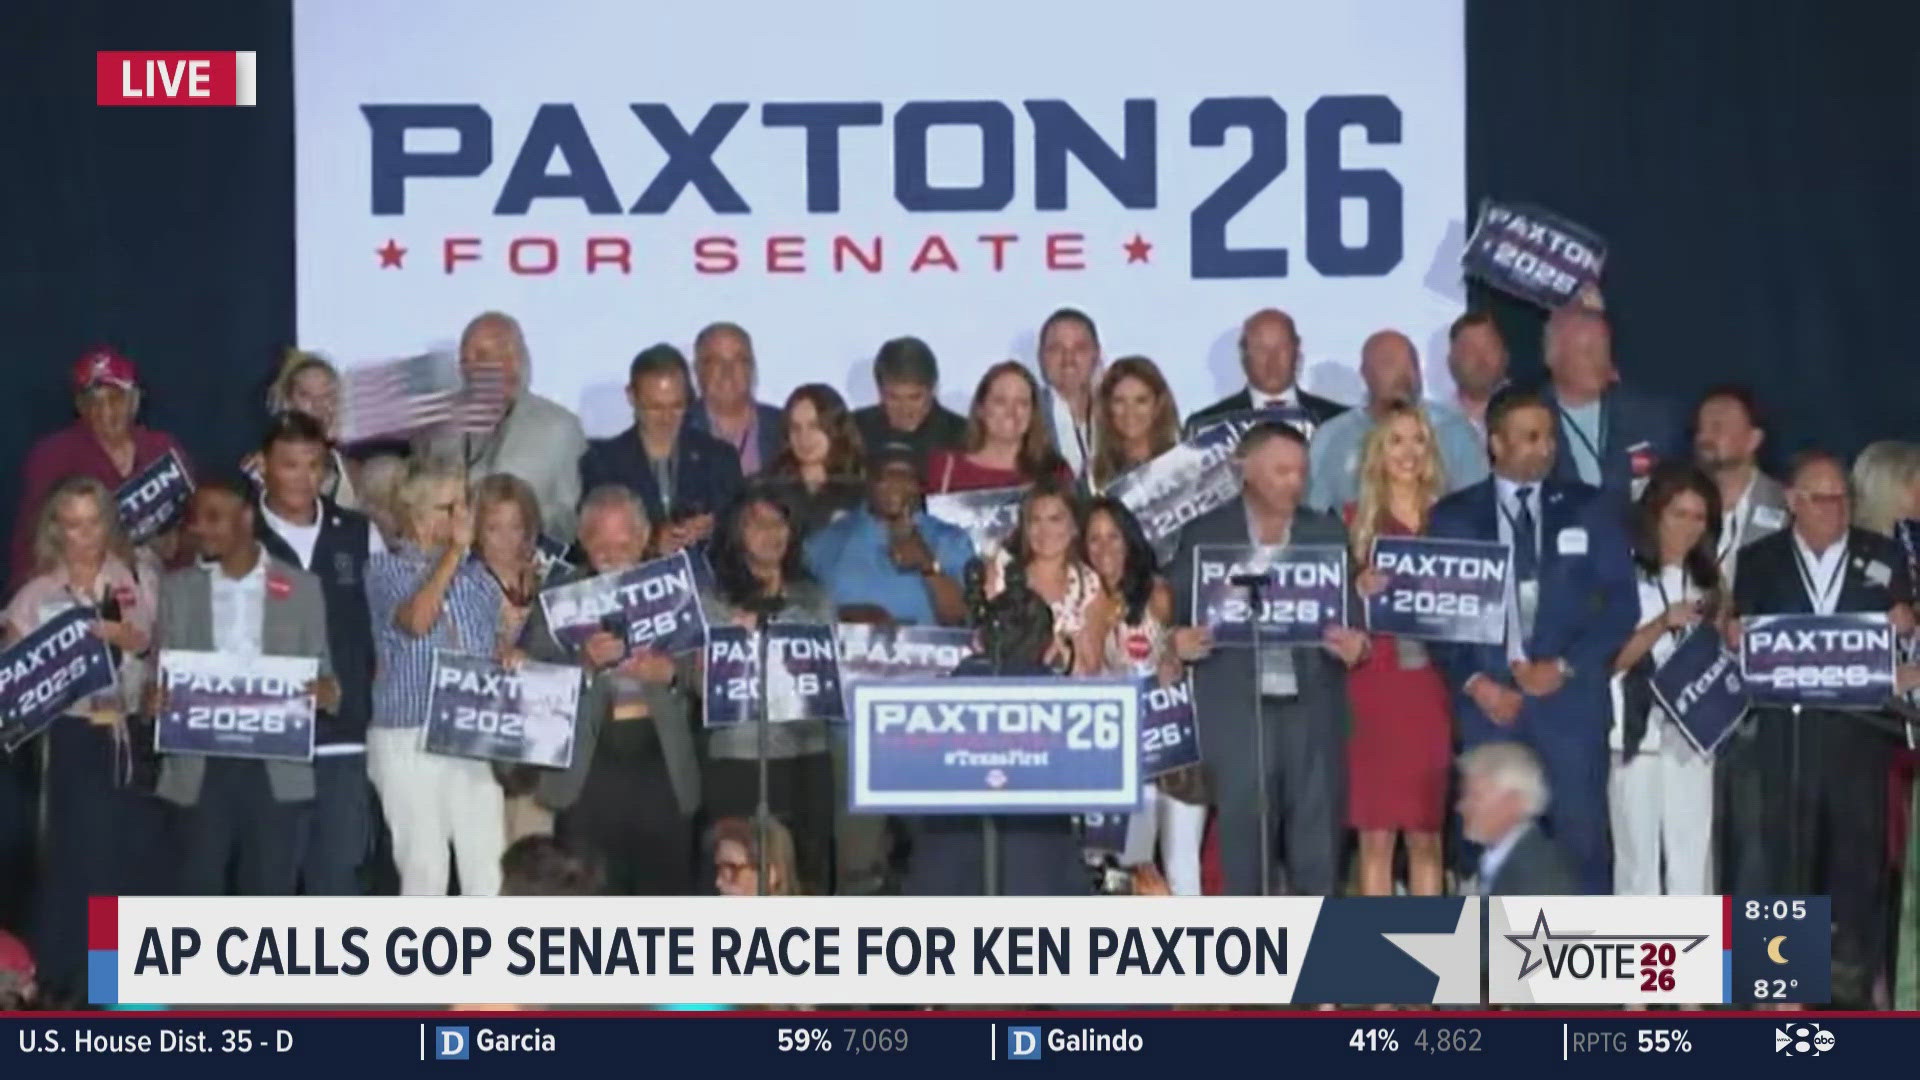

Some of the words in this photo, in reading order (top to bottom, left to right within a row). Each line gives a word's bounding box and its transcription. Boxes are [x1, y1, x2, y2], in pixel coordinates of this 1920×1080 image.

[359, 98, 1157, 215] PAXTON
[1190, 95, 1403, 279] 26
[444, 236, 632, 275] FOR
[694, 233, 1085, 273] SENATE
[1376, 552, 1505, 581] PAXTON
[1393, 589, 1481, 617] 2026
[1750, 629, 1890, 653] PAXTON
[18, 655, 87, 716] 2026
[1772, 665, 1870, 689] 2026
[187, 705, 287, 734] 2026
[453, 705, 524, 737] 202
[874, 703, 1063, 734] PAXTON
[1065, 703, 1121, 750] 26
